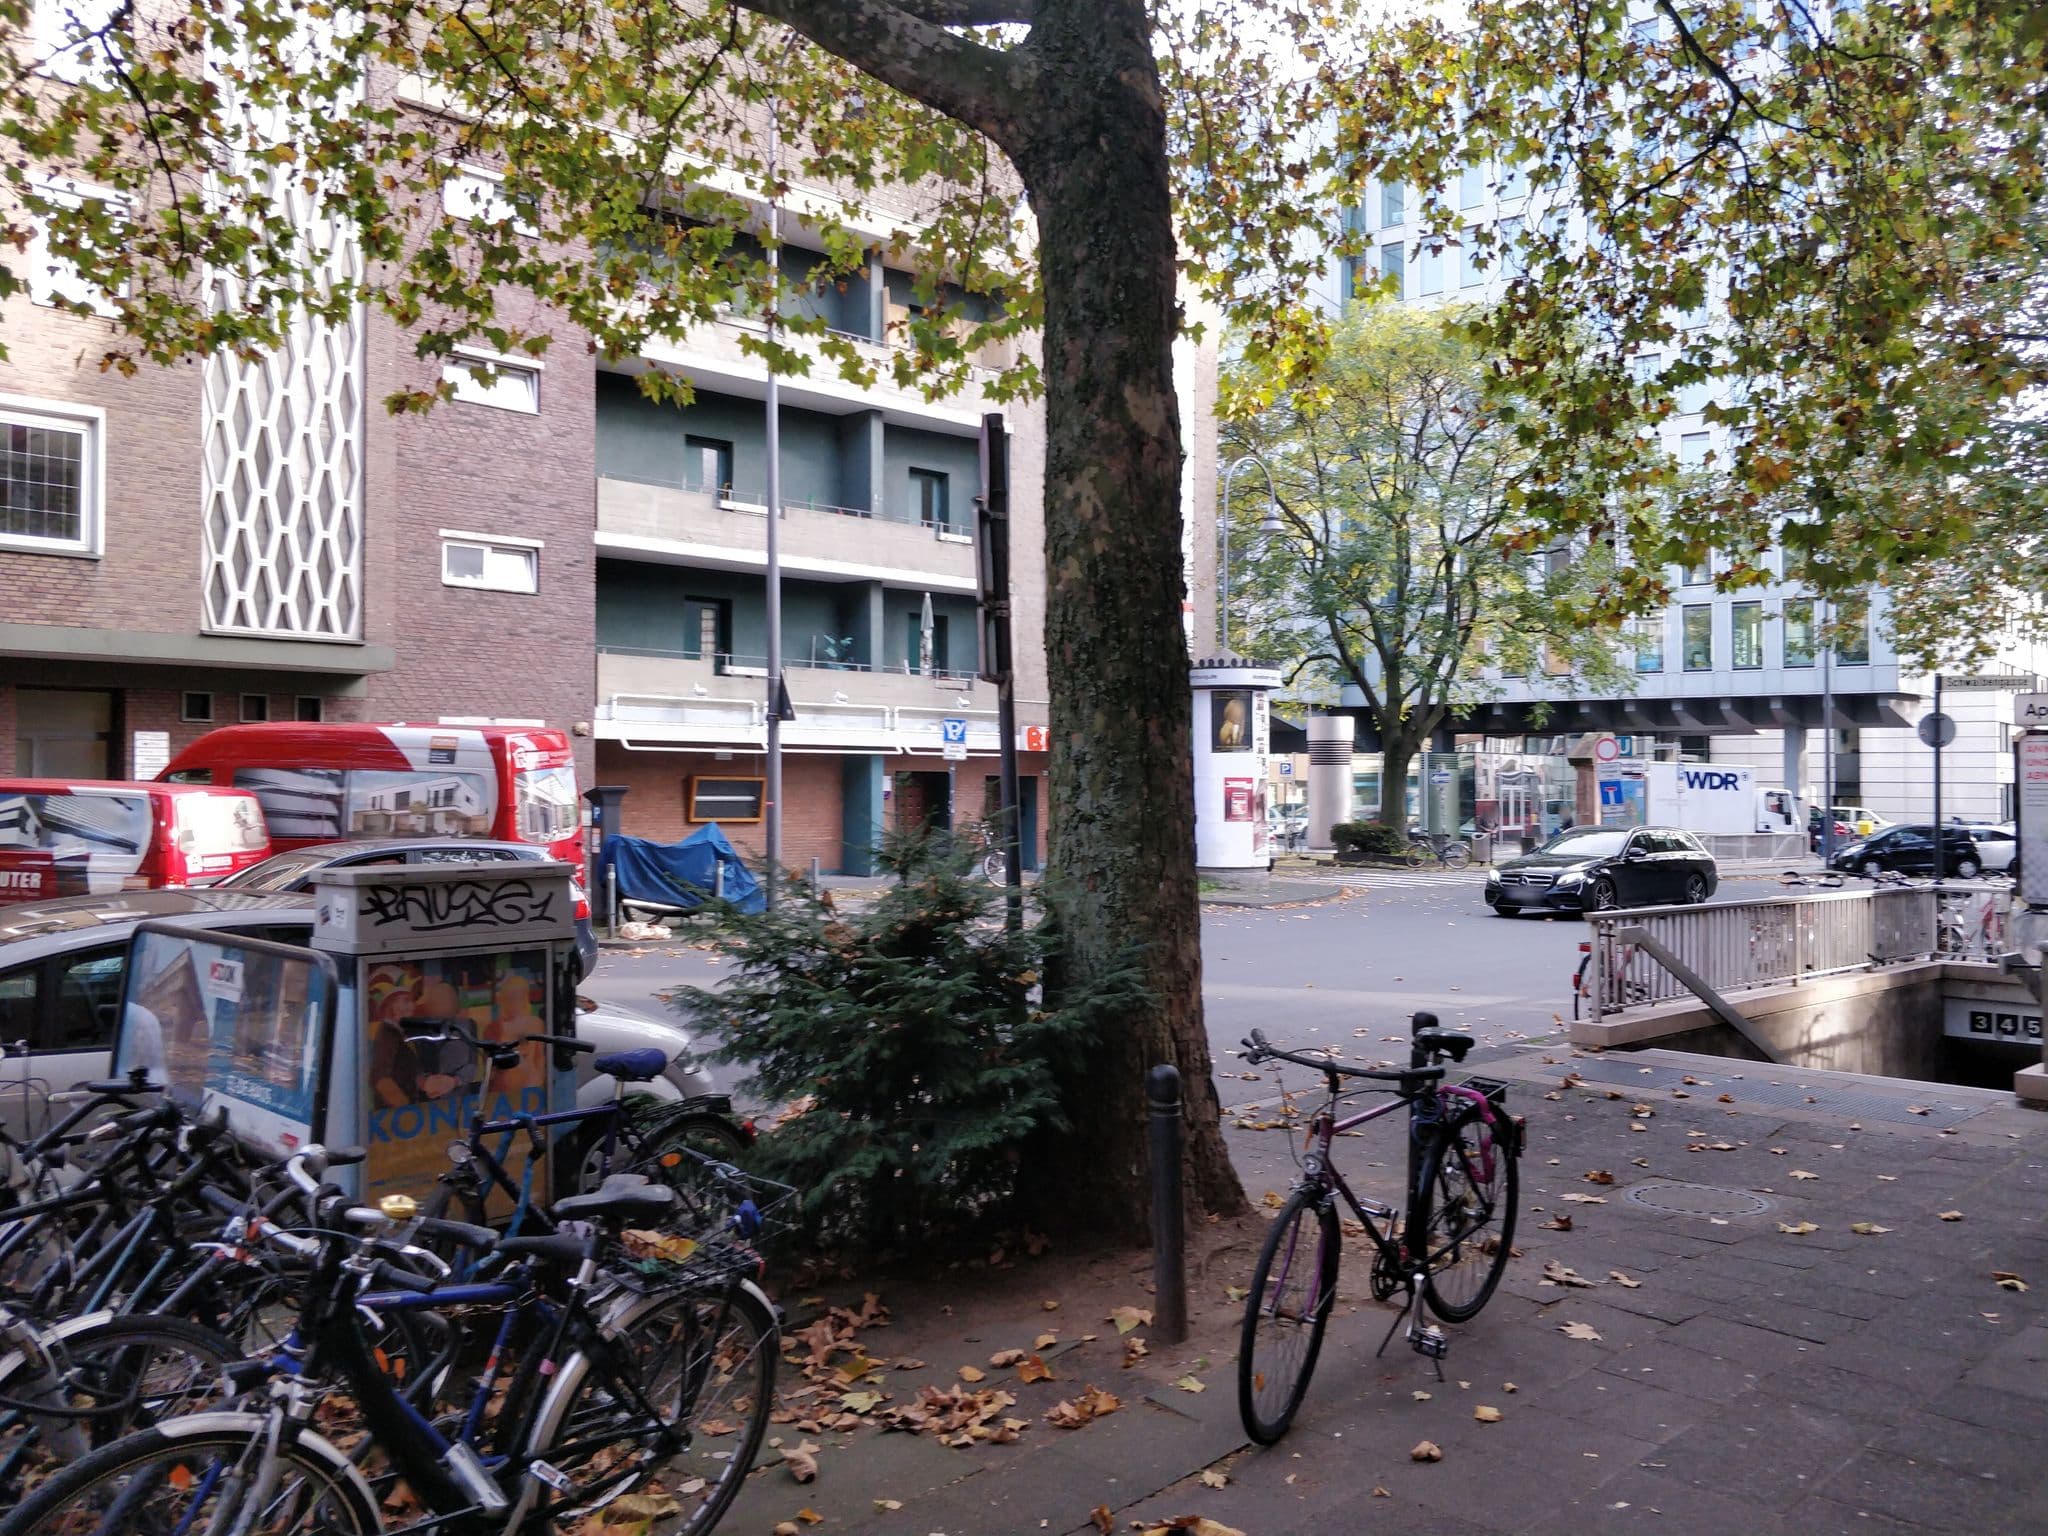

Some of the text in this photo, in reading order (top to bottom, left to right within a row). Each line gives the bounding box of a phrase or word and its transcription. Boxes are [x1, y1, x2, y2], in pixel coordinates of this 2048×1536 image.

[1685, 771, 1739, 791] WDR
[1975, 1015, 2041, 1034] 3 4 5
